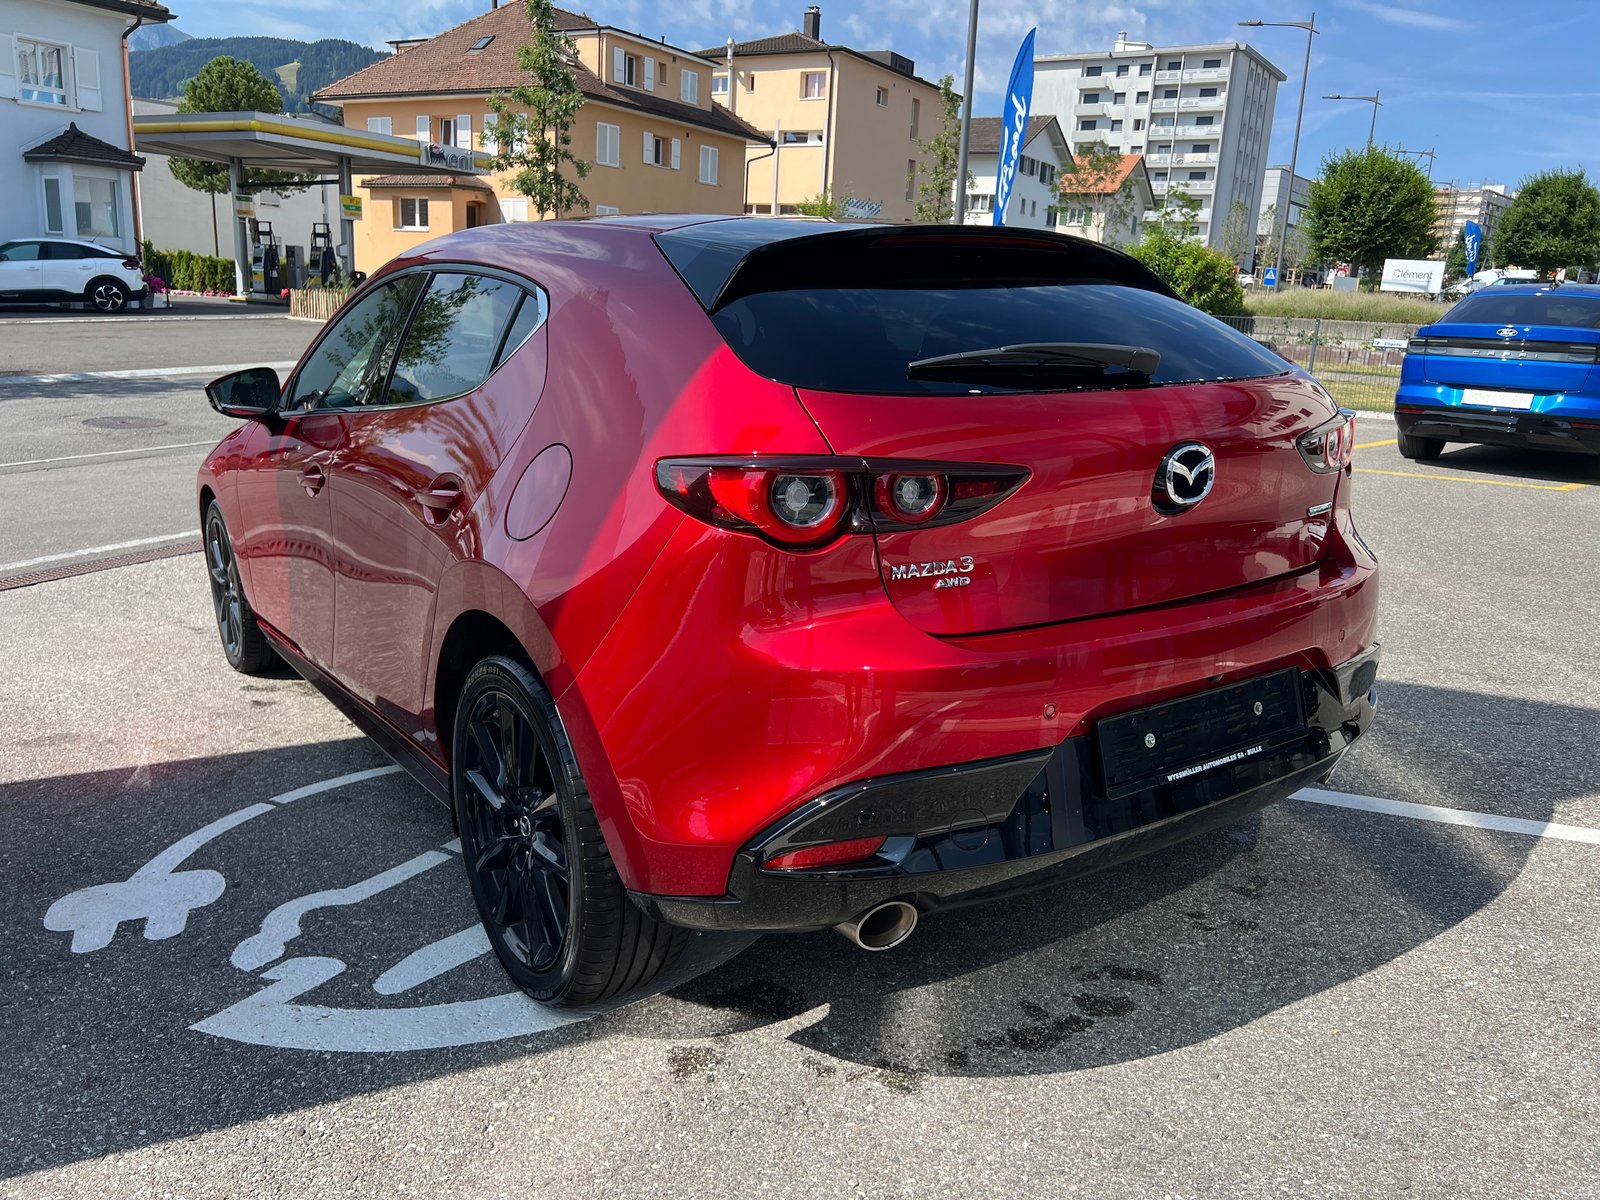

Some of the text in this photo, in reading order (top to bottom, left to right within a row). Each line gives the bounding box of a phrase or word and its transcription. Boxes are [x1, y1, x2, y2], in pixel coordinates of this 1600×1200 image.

[447, 150, 473, 171] eni
[997, 93, 1026, 224] Ford
[1393, 269, 1433, 280] Clément
[1472, 350, 1538, 358] CAPRI
[934, 576, 971, 589] AWD
[1167, 765, 1203, 782] WYSSMÜLLER
[1203, 753, 1237, 771] AUTOMOBILES
[1237, 751, 1245, 759] SA
[1247, 745, 1262, 756] BULLE
